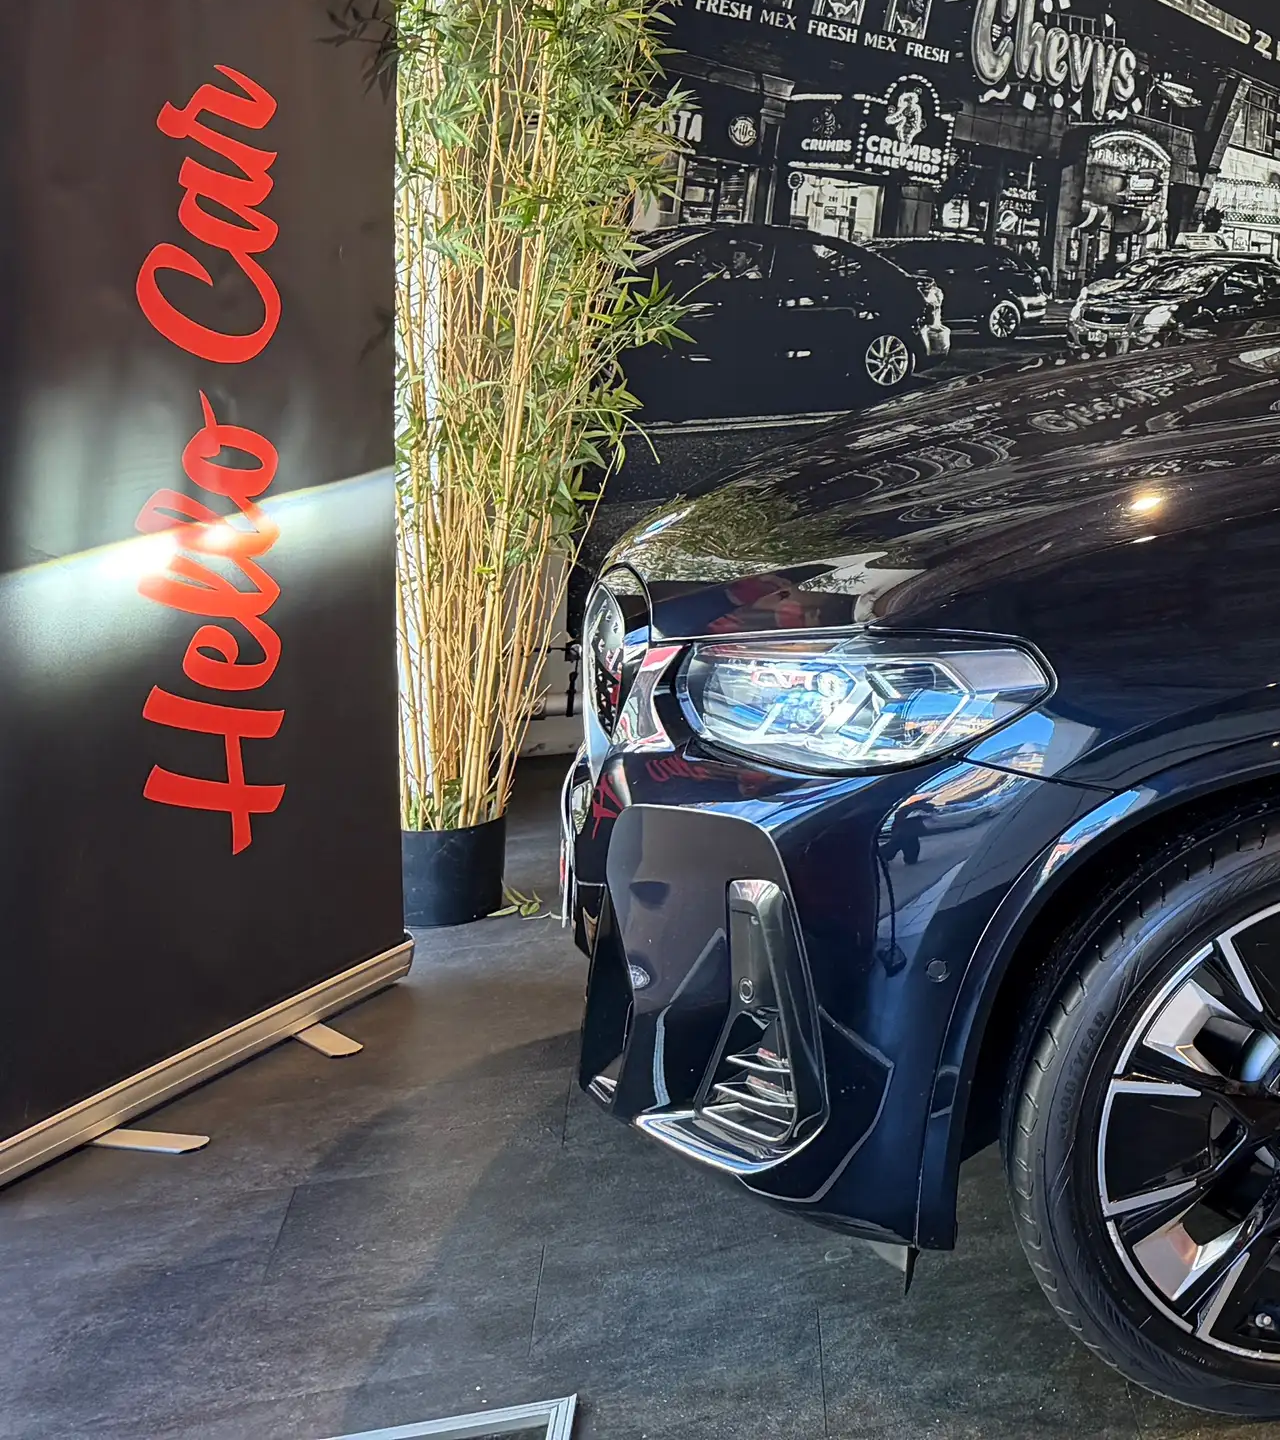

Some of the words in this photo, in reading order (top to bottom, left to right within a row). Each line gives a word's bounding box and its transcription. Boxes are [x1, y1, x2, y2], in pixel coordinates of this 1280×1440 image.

[760, 9, 797, 31] MEX
[807, 19, 857, 44] FRESH
[863, 32, 897, 52] MEX
[905, 42, 950, 64] FRESH
[801, 138, 852, 153] CRUMBS
[865, 152, 901, 168] BAKE
[905, 160, 940, 175] SHOP
[866, 135, 942, 164] CRUMBS
[135, 64, 282, 363] Car
[135, 389, 286, 855] Hello
